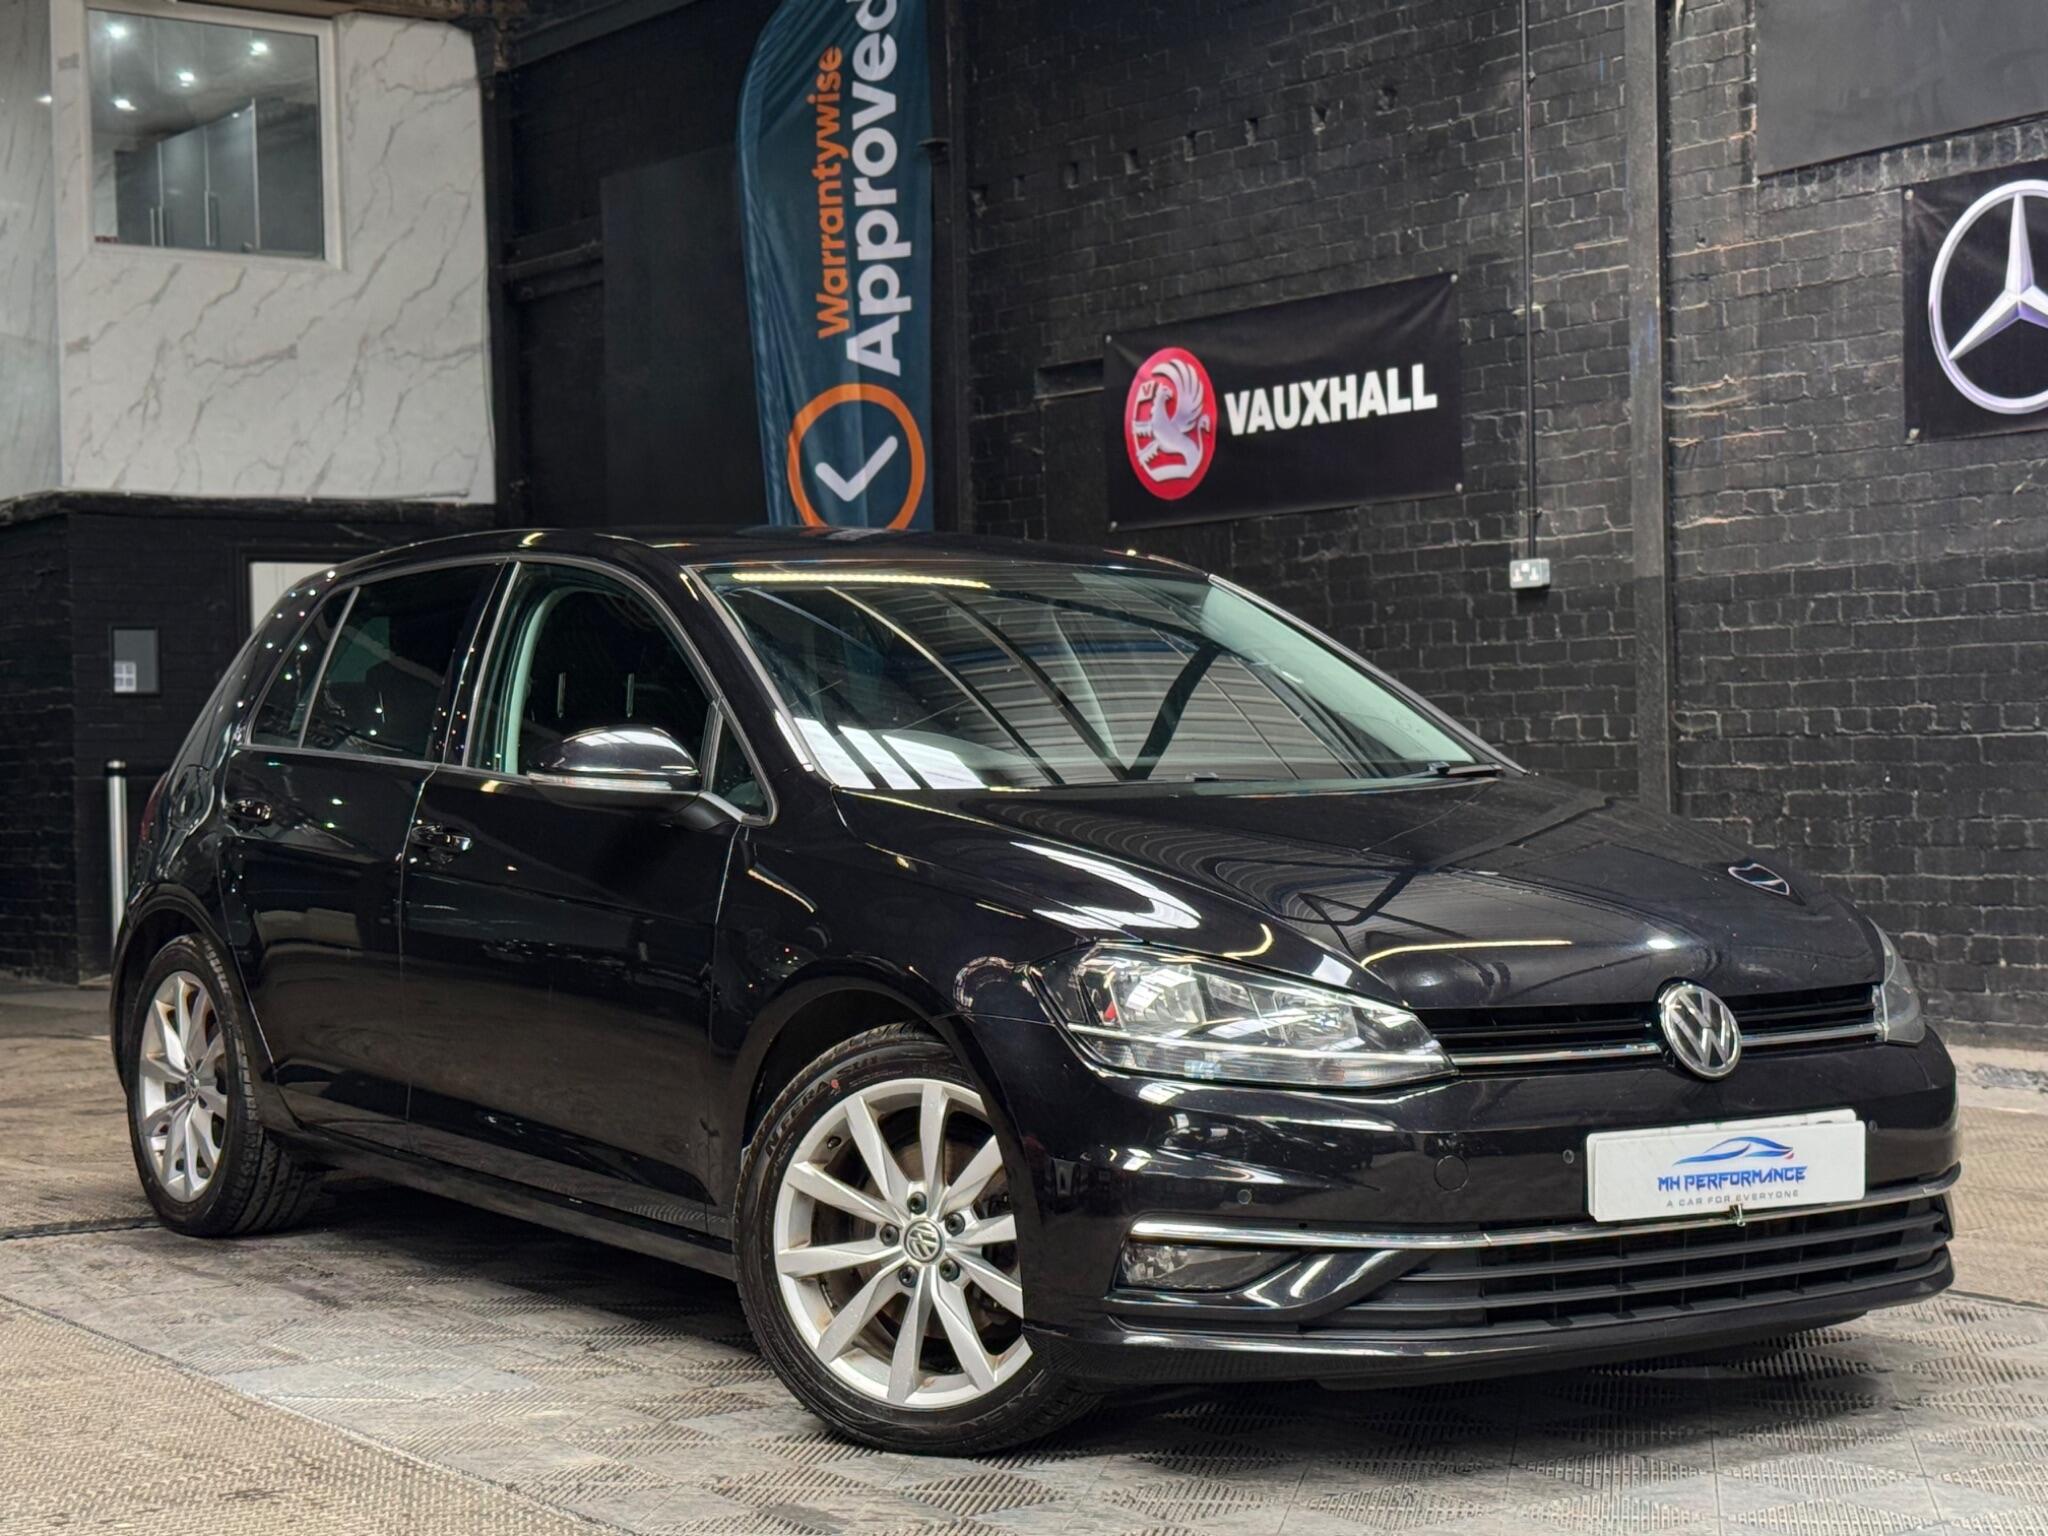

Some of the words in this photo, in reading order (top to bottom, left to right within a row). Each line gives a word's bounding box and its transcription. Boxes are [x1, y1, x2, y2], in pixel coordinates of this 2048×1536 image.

[807, 46, 850, 340] Warrantywise
[1224, 363, 1437, 436] VAUXHALL
[1657, 1176, 1680, 1192] MH
[1684, 1165, 1808, 1192] PERFORMANCE
[1678, 1197, 1703, 1207] CAR
[1707, 1195, 1731, 1204] FOR
[1735, 1189, 1799, 1202] EVERYONE
